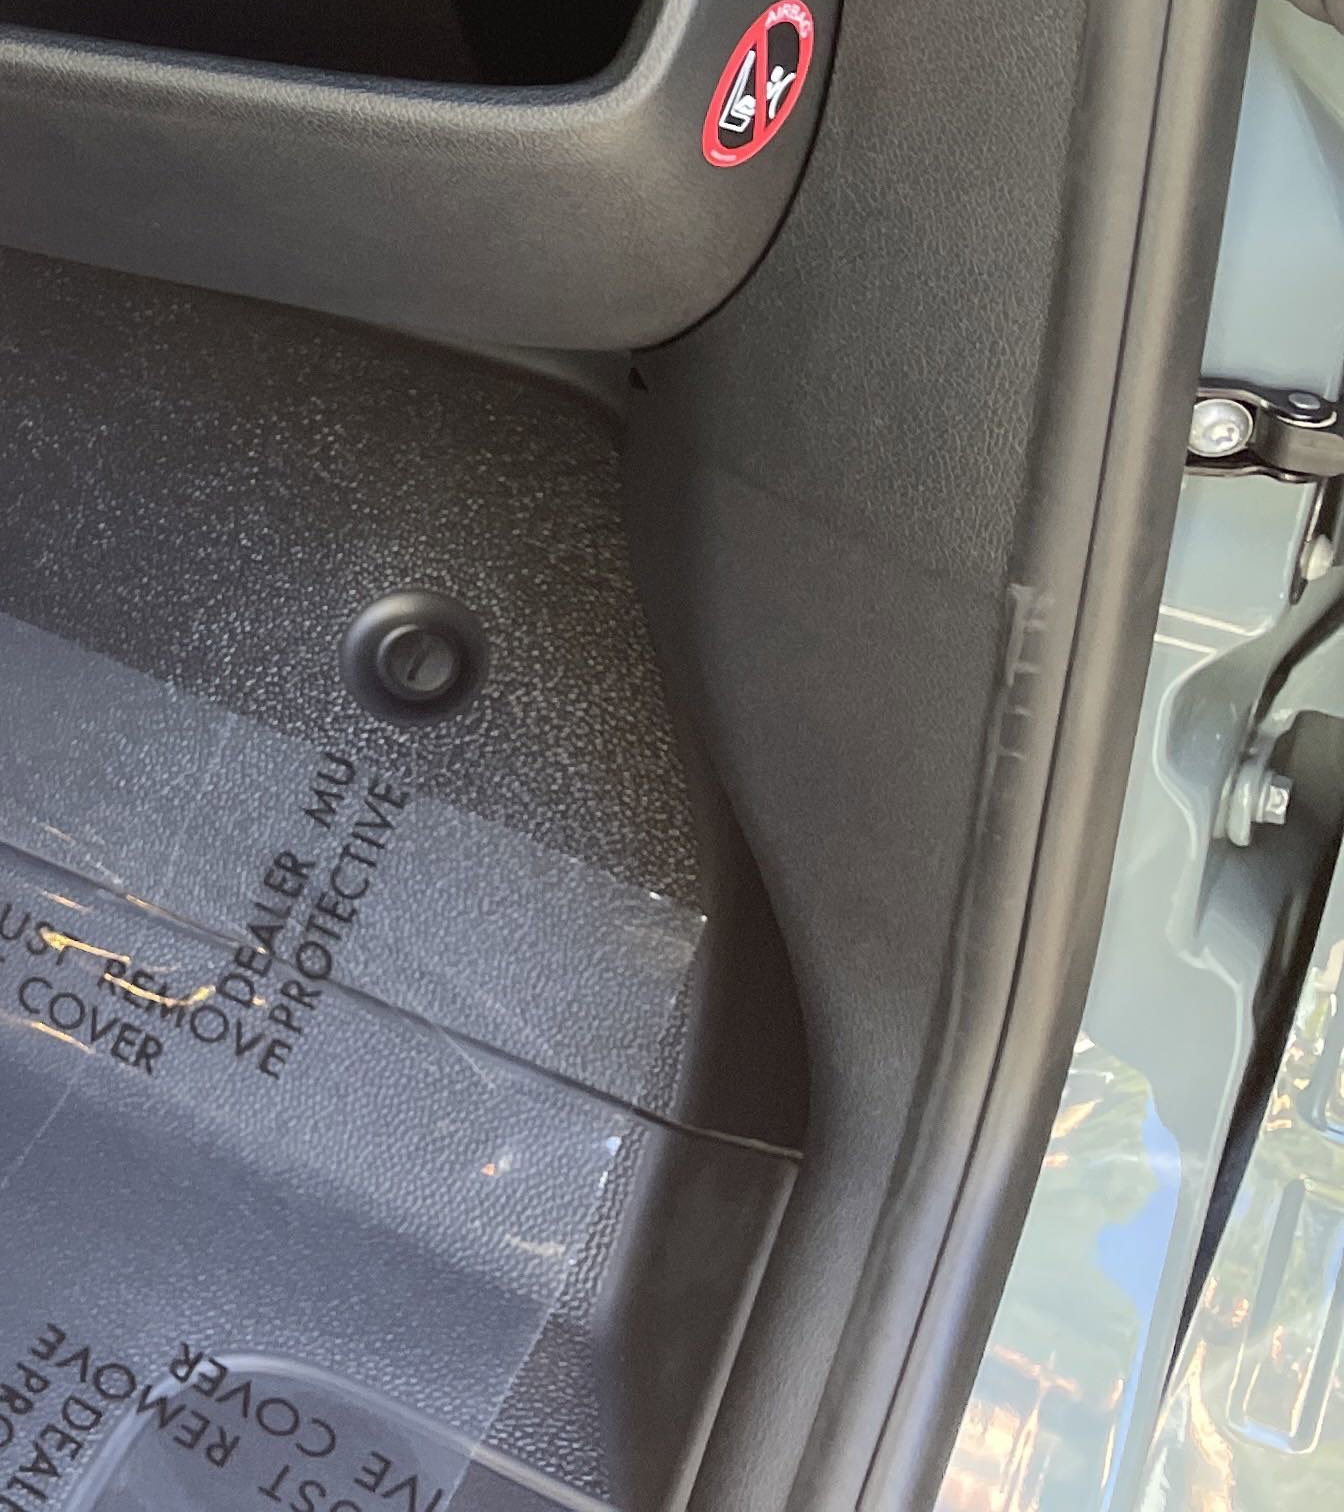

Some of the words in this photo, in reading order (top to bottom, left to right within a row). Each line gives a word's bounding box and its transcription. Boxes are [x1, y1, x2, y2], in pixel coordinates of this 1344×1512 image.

[215, 850, 316, 1008] DEALER
[301, 751, 357, 830] MU
[268, 778, 411, 1034] PROTECTIVE
[18, 976, 163, 1076] COVER
[96, 957, 293, 1080] REMOVE
[29, 1322, 240, 1468] REMOVE
[169, 1341, 336, 1458] COVER
